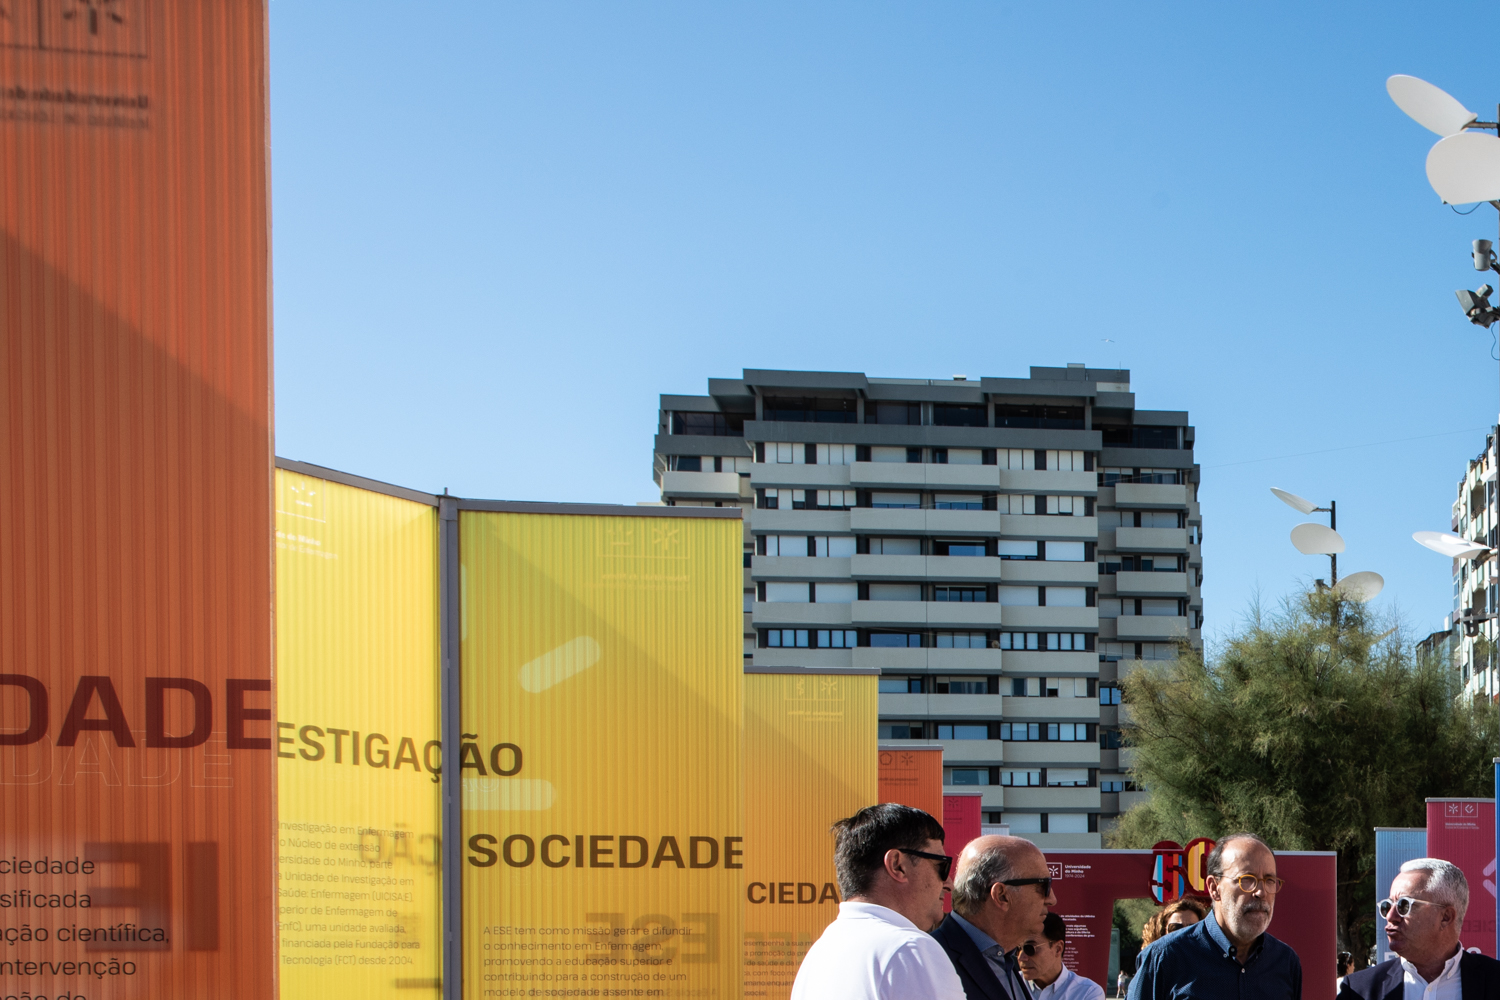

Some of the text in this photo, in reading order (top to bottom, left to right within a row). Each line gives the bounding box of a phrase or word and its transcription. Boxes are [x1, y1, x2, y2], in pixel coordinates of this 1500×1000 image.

[467, 834, 743, 869] SOCIEDADE
[0, 890, 91, 908] sificada
[0, 924, 169, 945] ção científica,
[484, 926, 490, 935] A
[494, 926, 512, 935] ESE
[573, 927, 610, 935] missão
[613, 928, 640, 937] gerar
[652, 926, 692, 935] difundir
[0, 958, 136, 979] ntervenção
